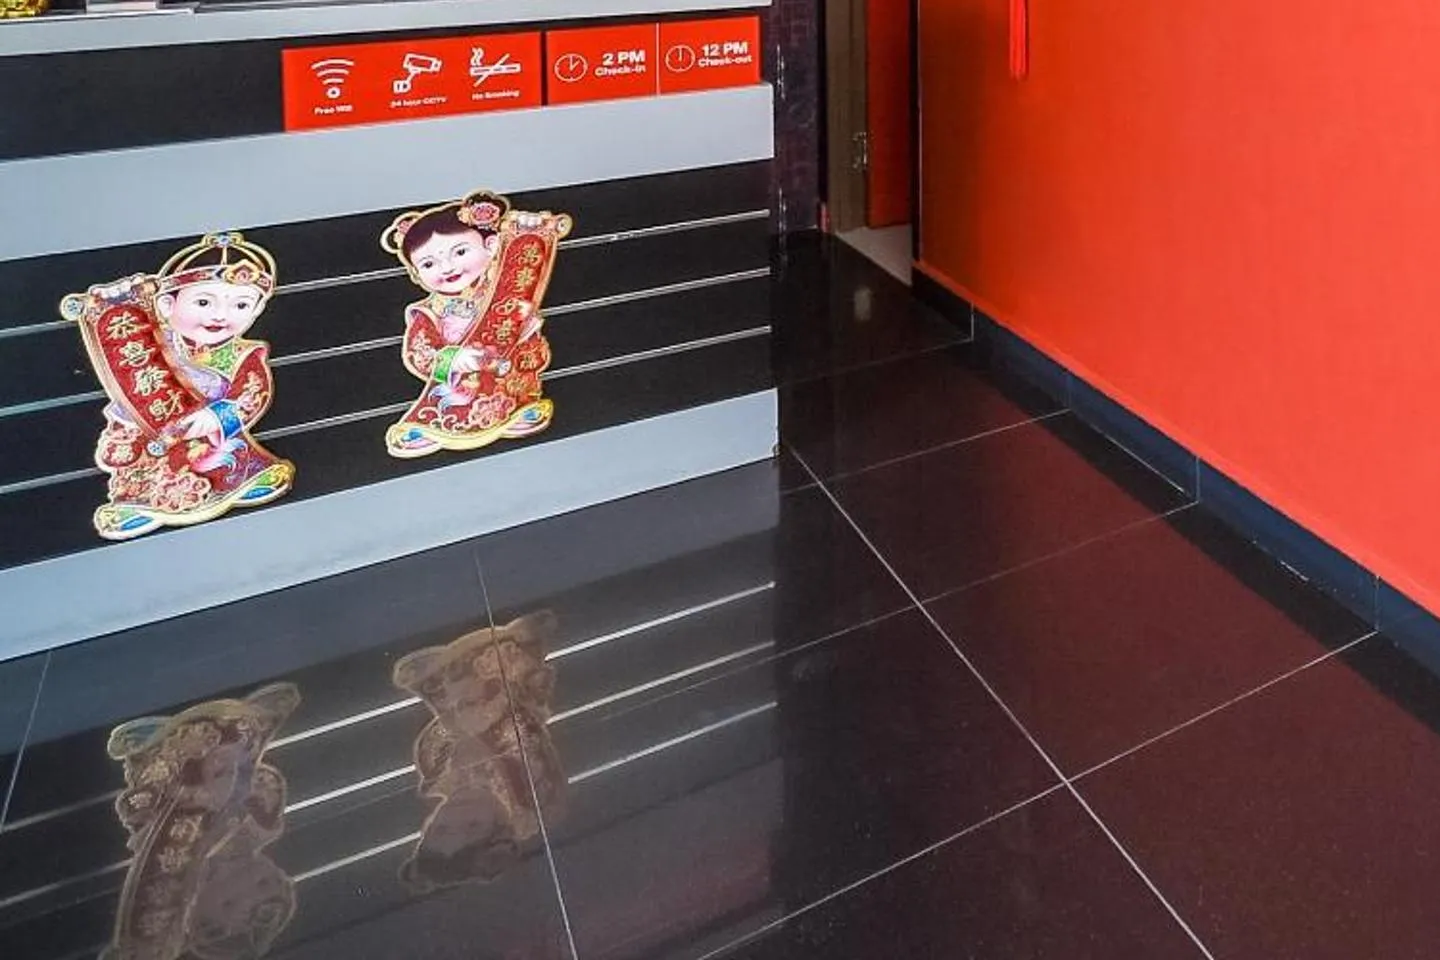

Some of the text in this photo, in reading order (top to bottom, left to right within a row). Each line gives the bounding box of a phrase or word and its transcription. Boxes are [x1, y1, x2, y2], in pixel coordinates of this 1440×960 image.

[702, 41, 749, 57] 12 PM
[602, 49, 646, 66] 2 PM
[698, 55, 753, 68] Check-out
[594, 64, 646, 76] Check-in
